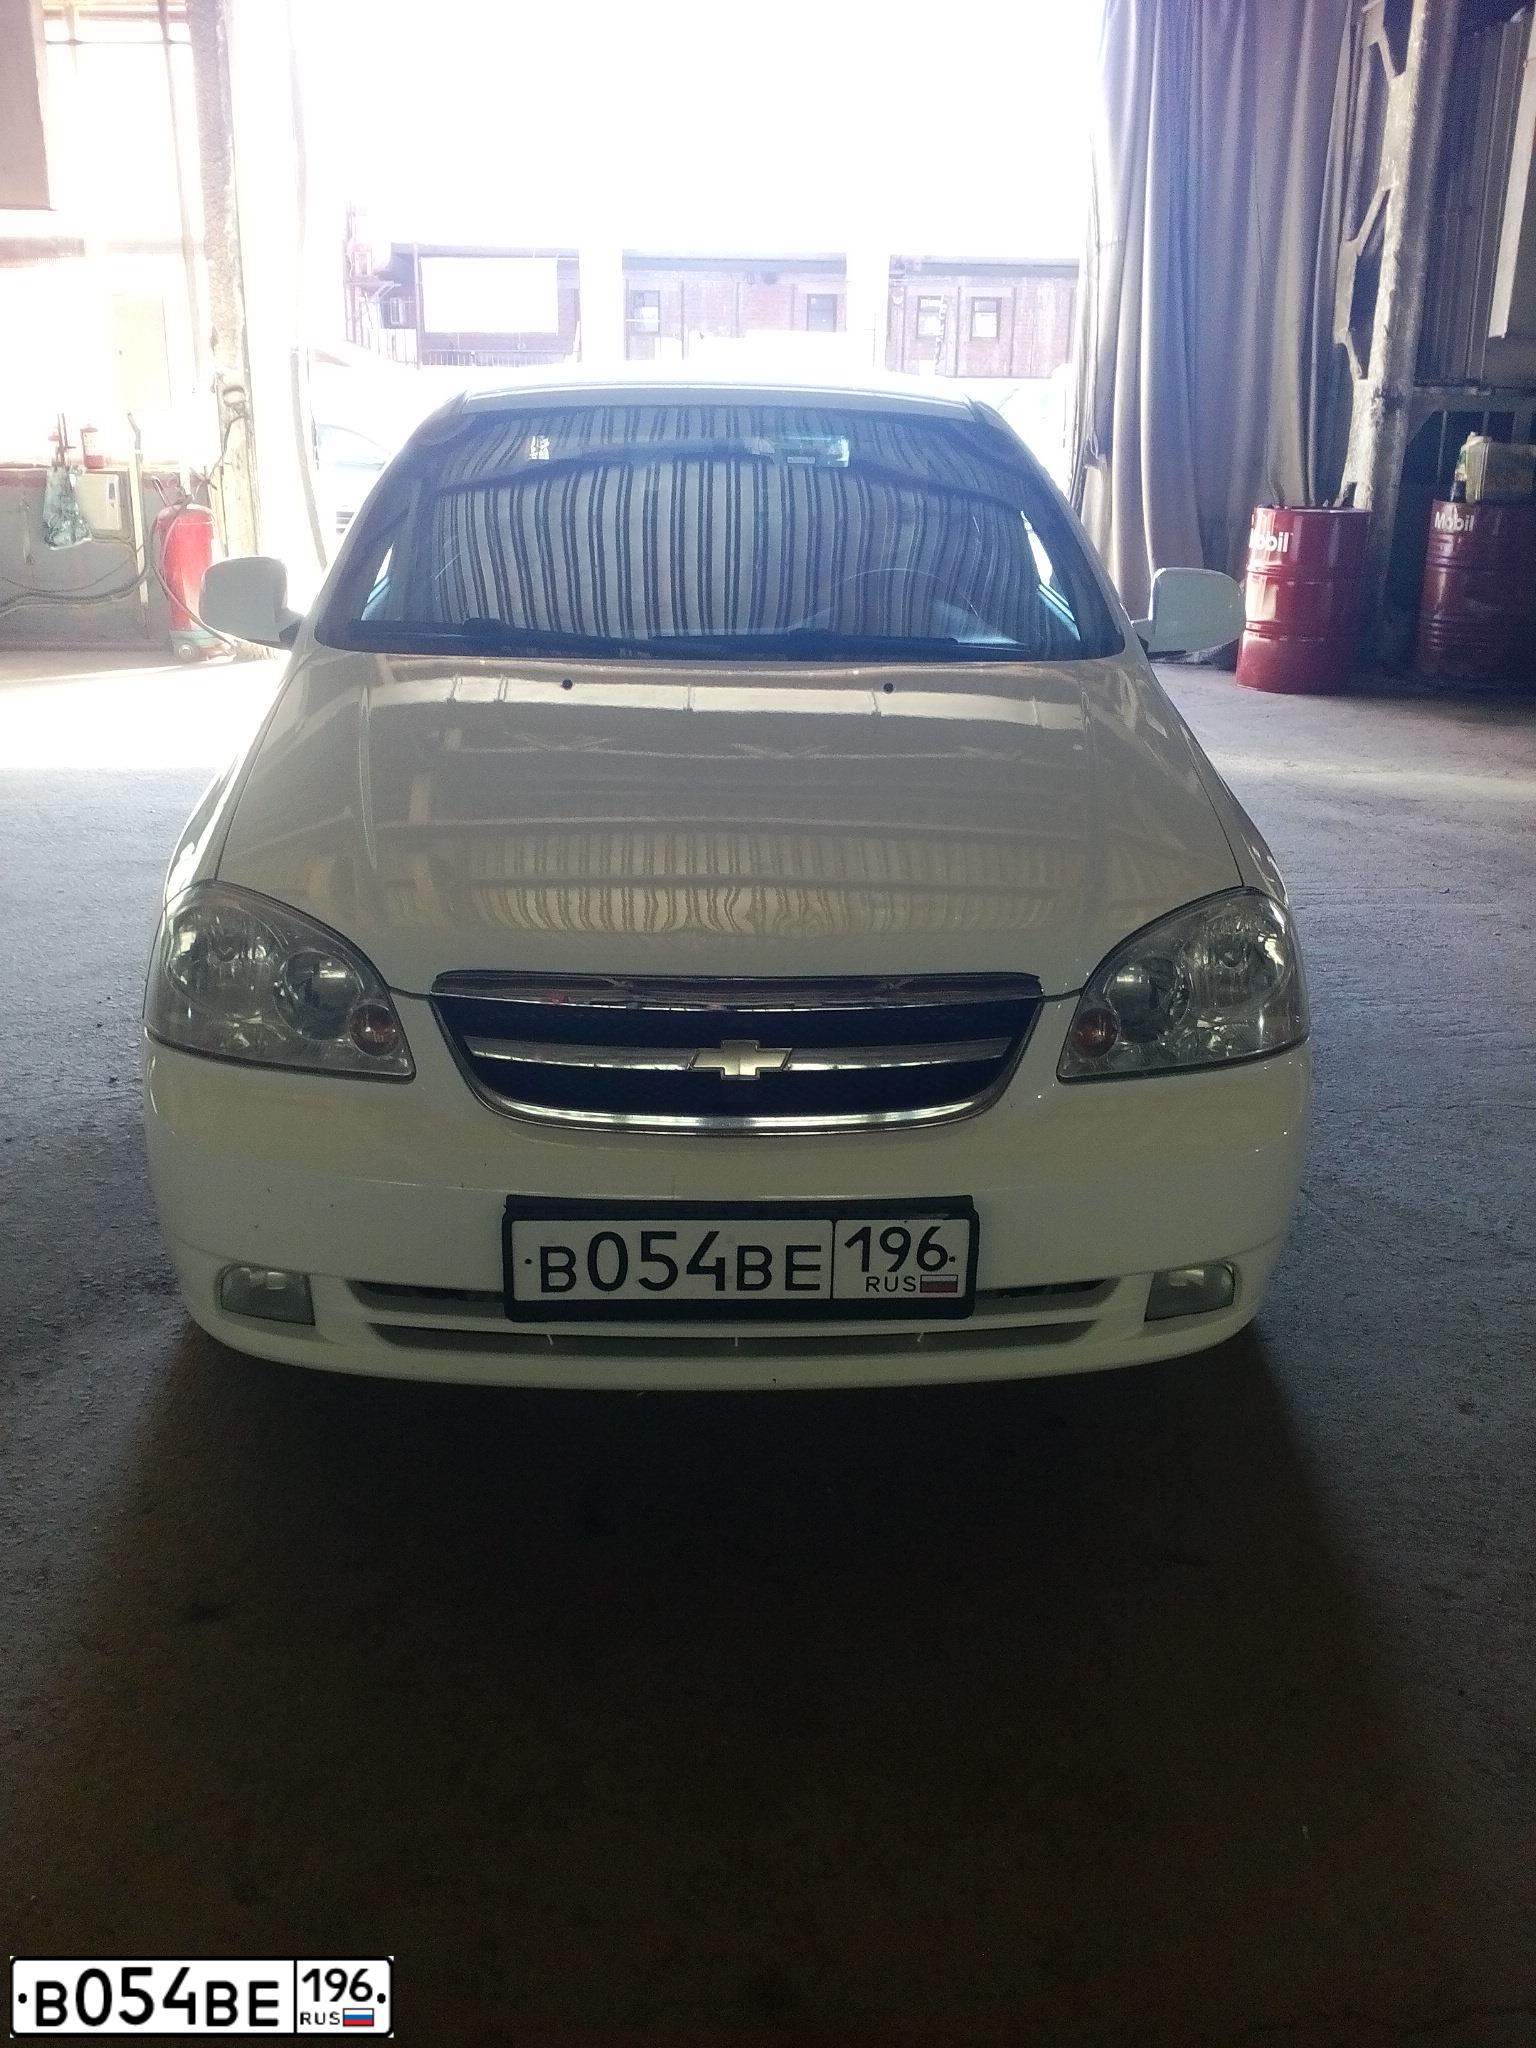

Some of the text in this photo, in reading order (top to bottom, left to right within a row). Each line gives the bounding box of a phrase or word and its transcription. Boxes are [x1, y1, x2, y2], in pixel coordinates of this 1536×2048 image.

[1434, 511, 1475, 532] Mobil
[539, 1225, 949, 1294] B054BE 196
[865, 1275, 917, 1293] RUS
